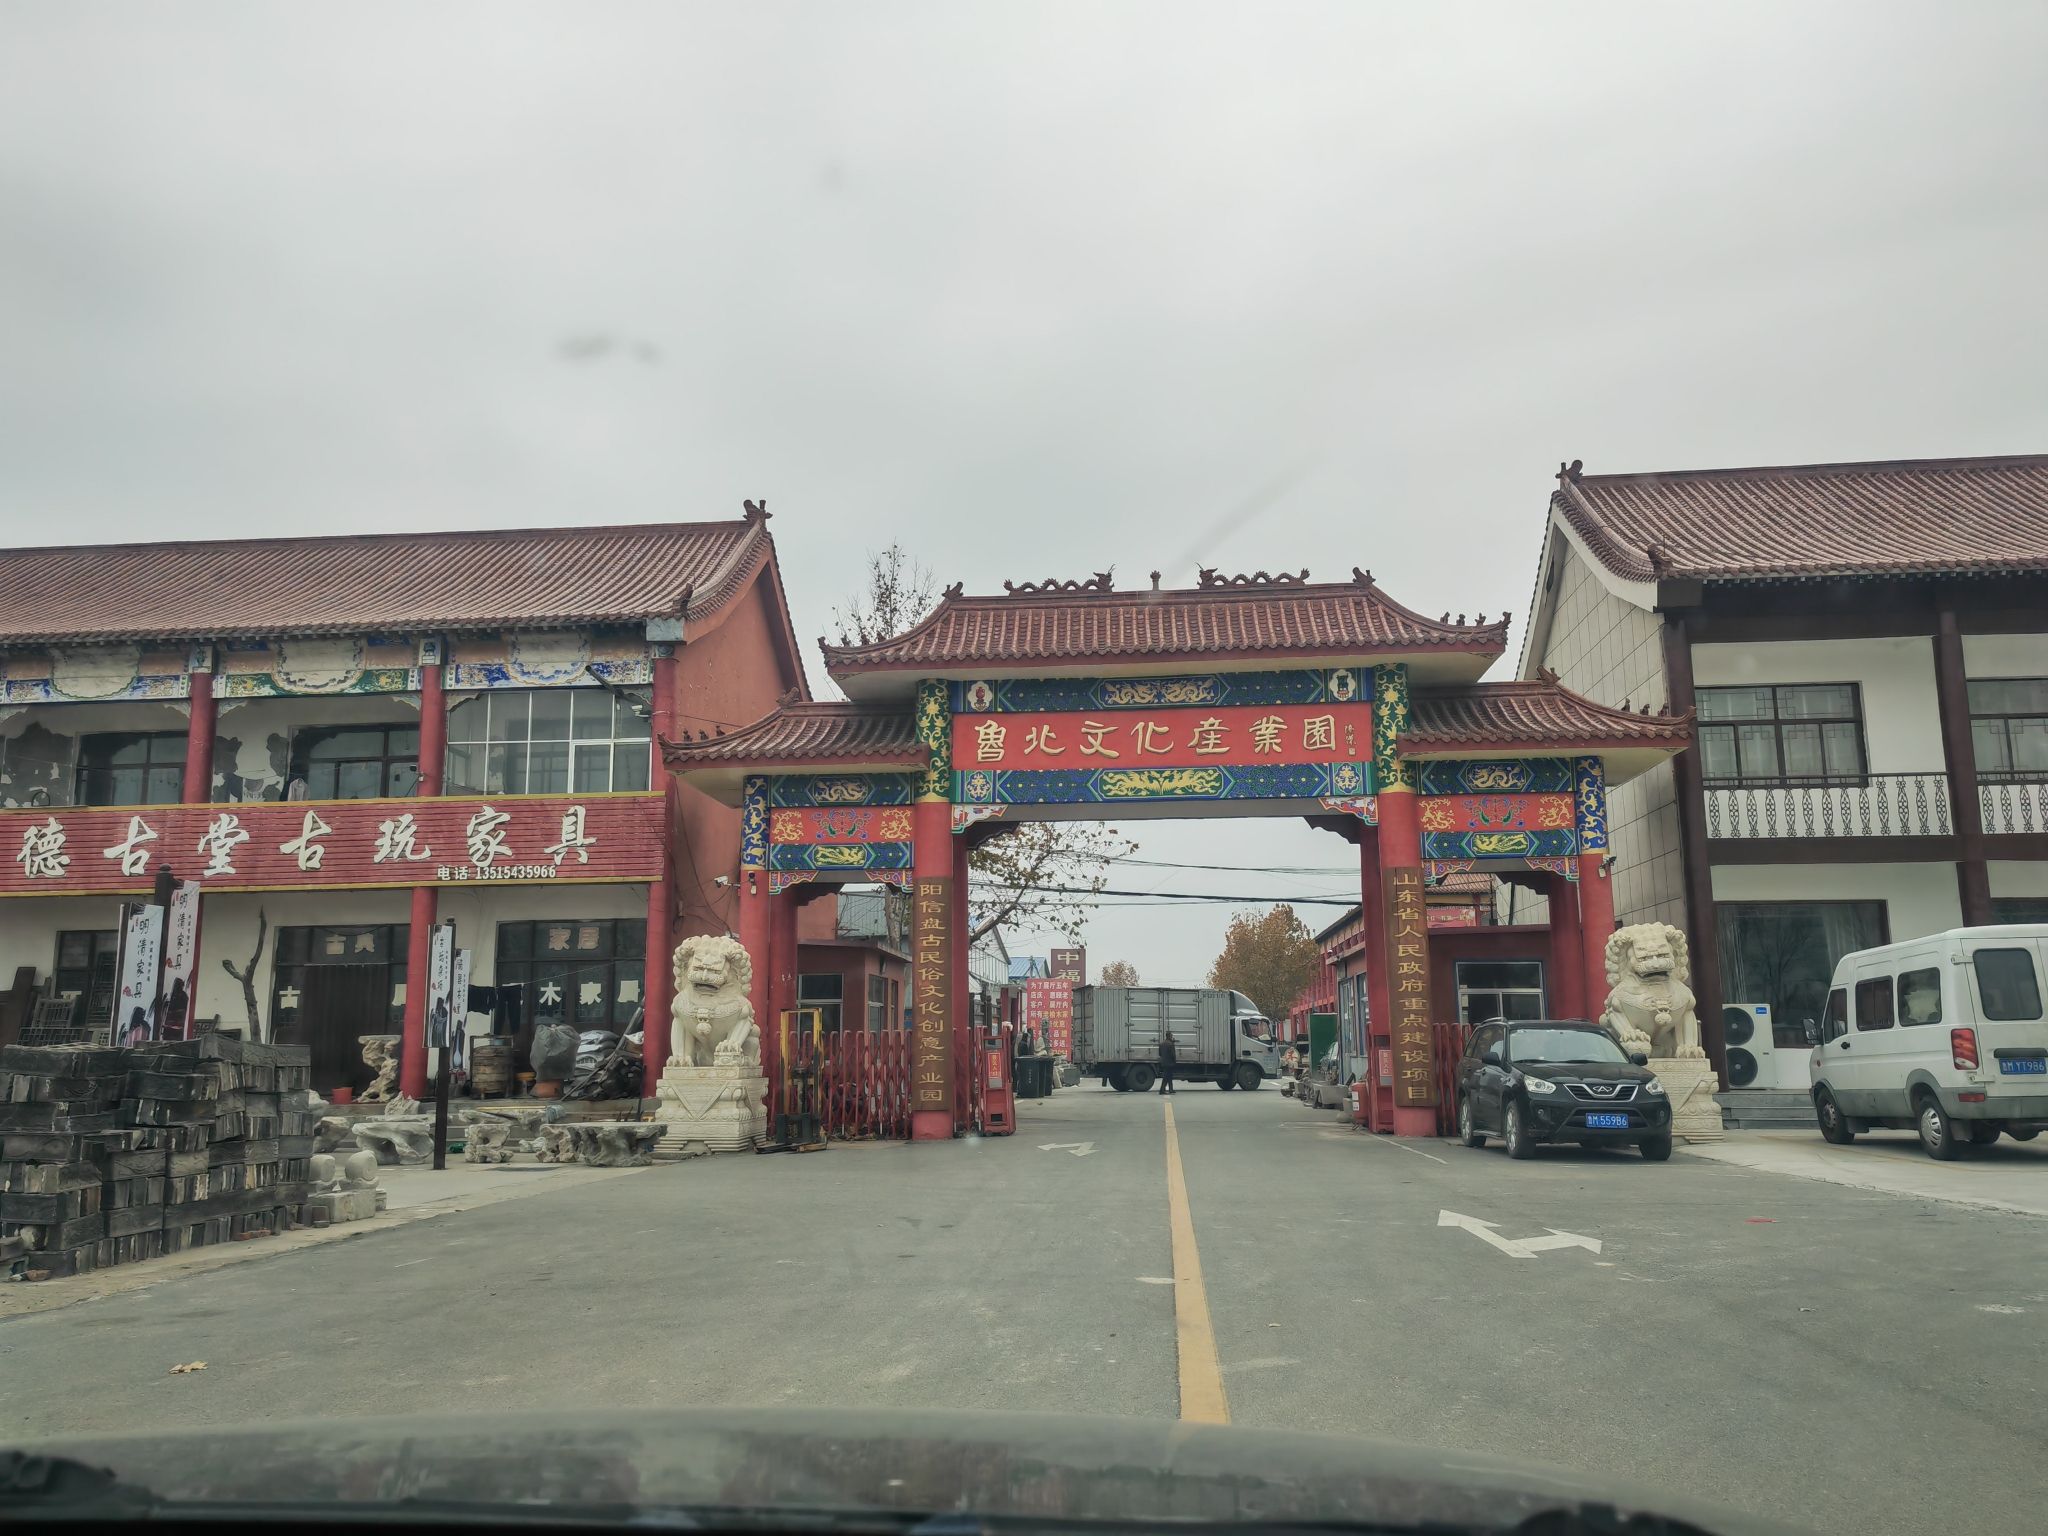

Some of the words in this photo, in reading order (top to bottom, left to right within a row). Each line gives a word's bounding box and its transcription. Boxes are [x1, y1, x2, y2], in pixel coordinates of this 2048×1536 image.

[16, 804, 598, 878] 德古堂古玩家具
[437, 866, 469, 880] 电话
[475, 864, 556, 880] 13515435966
[548, 927, 600, 951] 家居
[917, 884, 946, 1101] 阳信盘古民俗文化创意产业园
[1393, 873, 1430, 1099] 山东省人民政府重点建设项目
